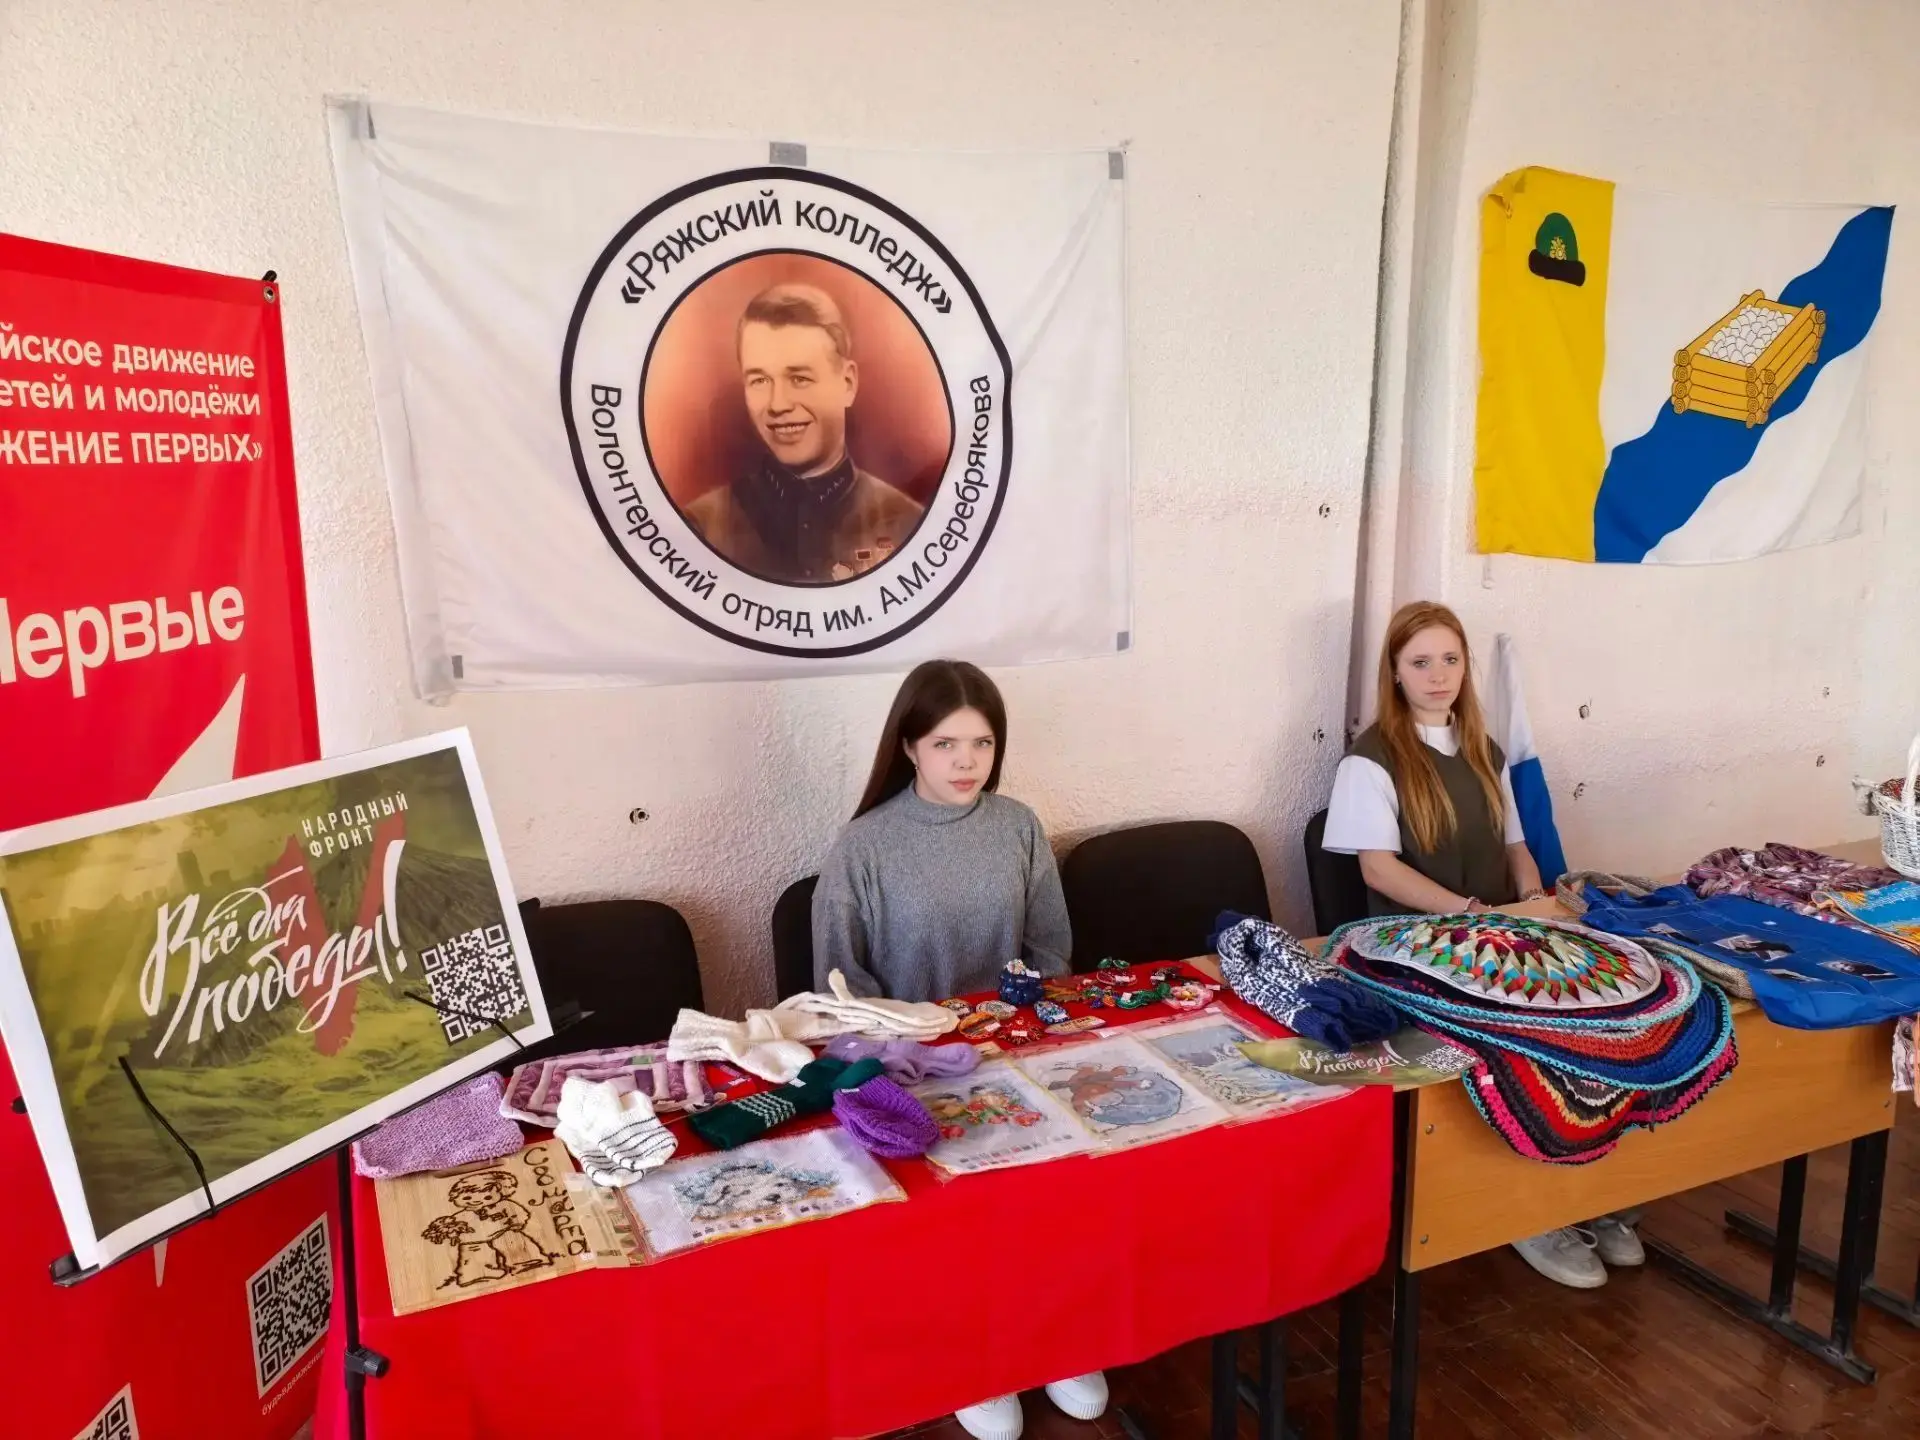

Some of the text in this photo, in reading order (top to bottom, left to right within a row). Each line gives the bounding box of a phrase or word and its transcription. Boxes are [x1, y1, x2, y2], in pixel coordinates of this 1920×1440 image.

[620, 190, 953, 314] «Ряжский колледж»
[112, 343, 255, 378] движение
[84, 384, 106, 411] и
[115, 385, 261, 419] молодёжи
[131, 432, 263, 465] ПЕРВЫХ»
[590, 383, 719, 601] Волонтерский
[722, 592, 815, 638] отряд
[823, 605, 874, 634] им.
[302, 791, 408, 838] НАРОДНЫЙ
[309, 825, 374, 857] ФРОНТ
[187, 839, 408, 1044] победы!
[140, 893, 242, 1059] Всё
